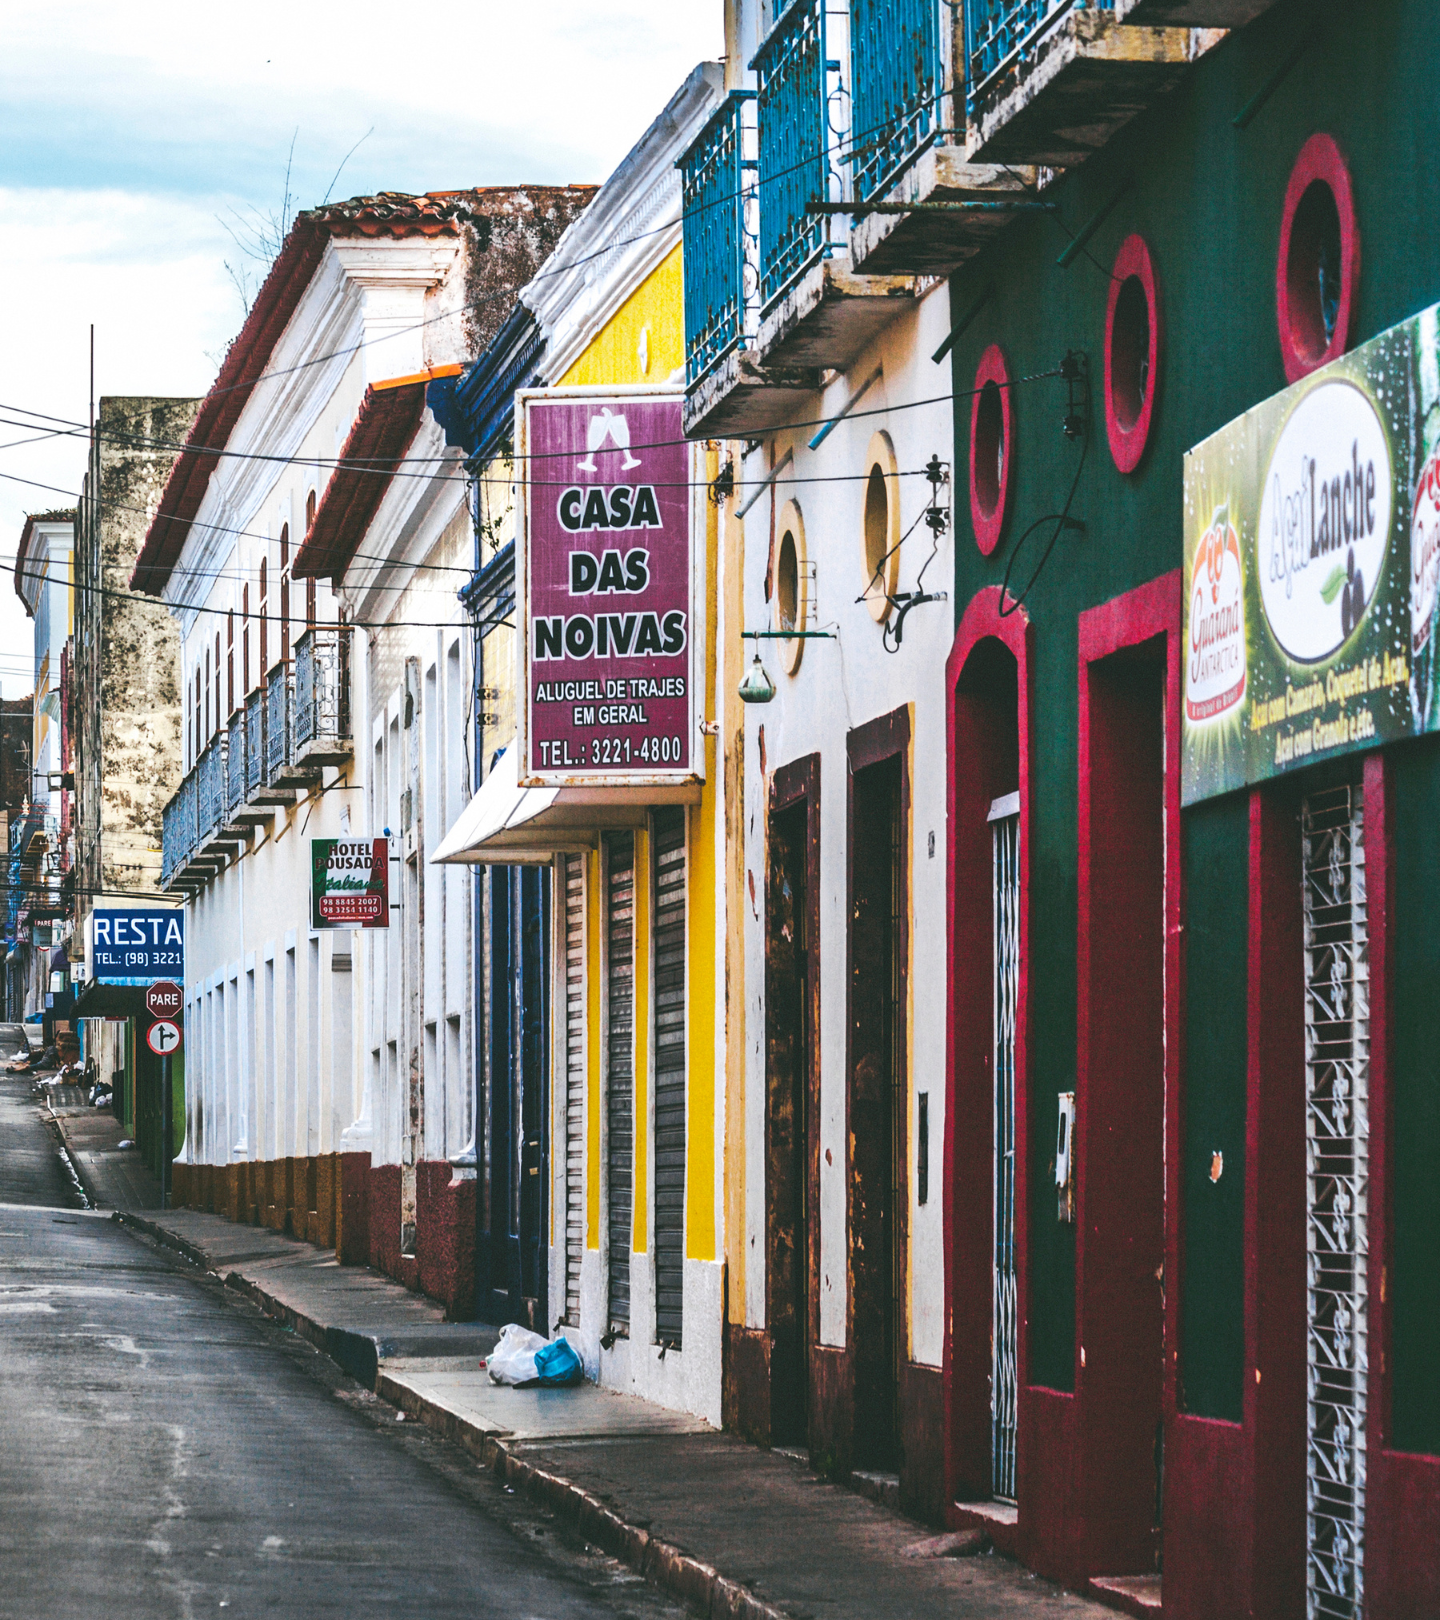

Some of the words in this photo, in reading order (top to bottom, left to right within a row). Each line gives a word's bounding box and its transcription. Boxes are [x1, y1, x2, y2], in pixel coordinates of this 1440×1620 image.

[558, 485, 662, 532] CASA
[1309, 438, 1375, 559] Lanche
[568, 547, 650, 596] DAS
[533, 609, 686, 661] NOIVAS
[1191, 587, 1239, 684] Guaraná
[1200, 641, 1239, 683] ANTARCTICA
[536, 682, 603, 701] ALUGUEL
[606, 681, 627, 699] DE
[629, 678, 685, 697] TRAJES
[1268, 696, 1286, 724] com
[1326, 658, 1368, 707] Coquetel
[1368, 655, 1381, 690] de
[574, 706, 596, 726] EM
[598, 704, 647, 725] GERAL
[1294, 729, 1312, 758] com
[1313, 711, 1349, 751] Granola
[540, 742, 587, 766] TEL.:
[592, 737, 682, 764] 3221-4800
[315, 856, 384, 870] POUSADA
[328, 843, 372, 856] HOTEL
[315, 872, 385, 892] Italiana
[37, 919, 51, 927] PARE
[94, 918, 183, 945] RESTA
[95, 953, 121, 964] TEL.:
[125, 953, 149, 967] (98)
[150, 993, 178, 1006] PARE
